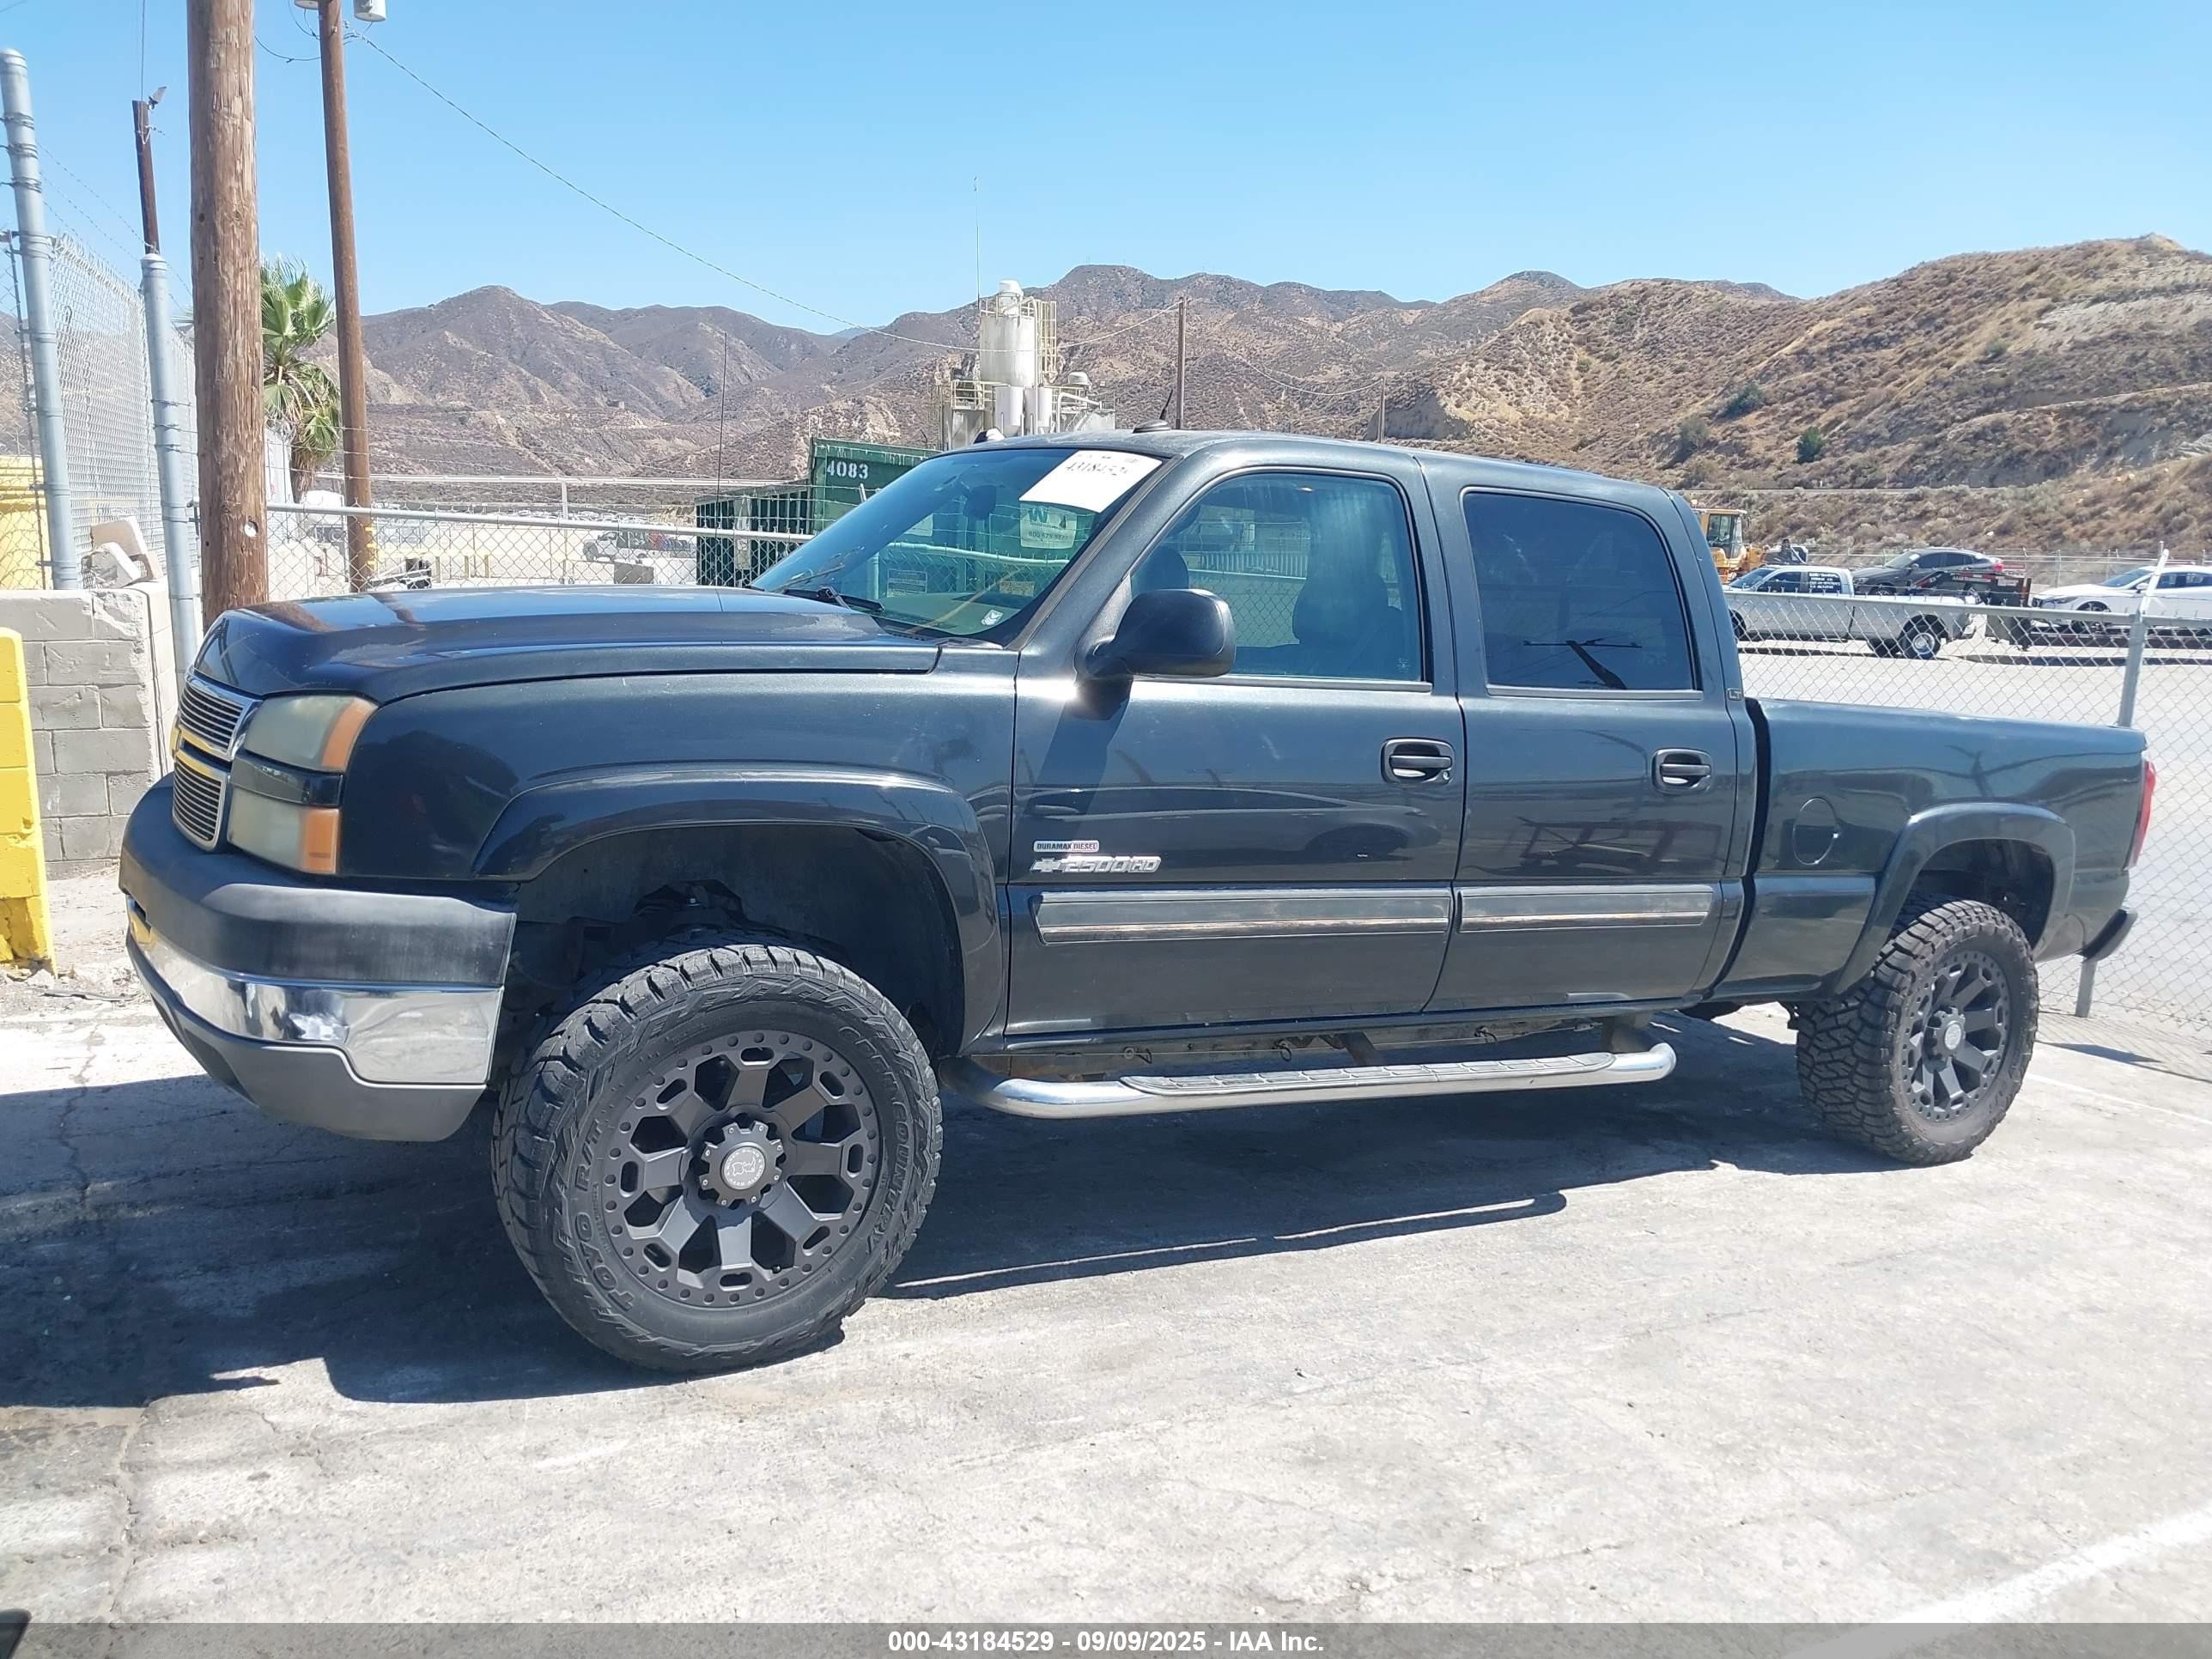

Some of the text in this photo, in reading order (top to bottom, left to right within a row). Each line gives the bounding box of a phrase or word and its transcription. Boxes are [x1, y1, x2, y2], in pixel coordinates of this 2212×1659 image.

[827, 459, 869, 479] 4083
[1729, 690, 1742, 699] LT
[1073, 842, 1098, 851] DIESEL
[574, 1212, 634, 1311] TOYO
